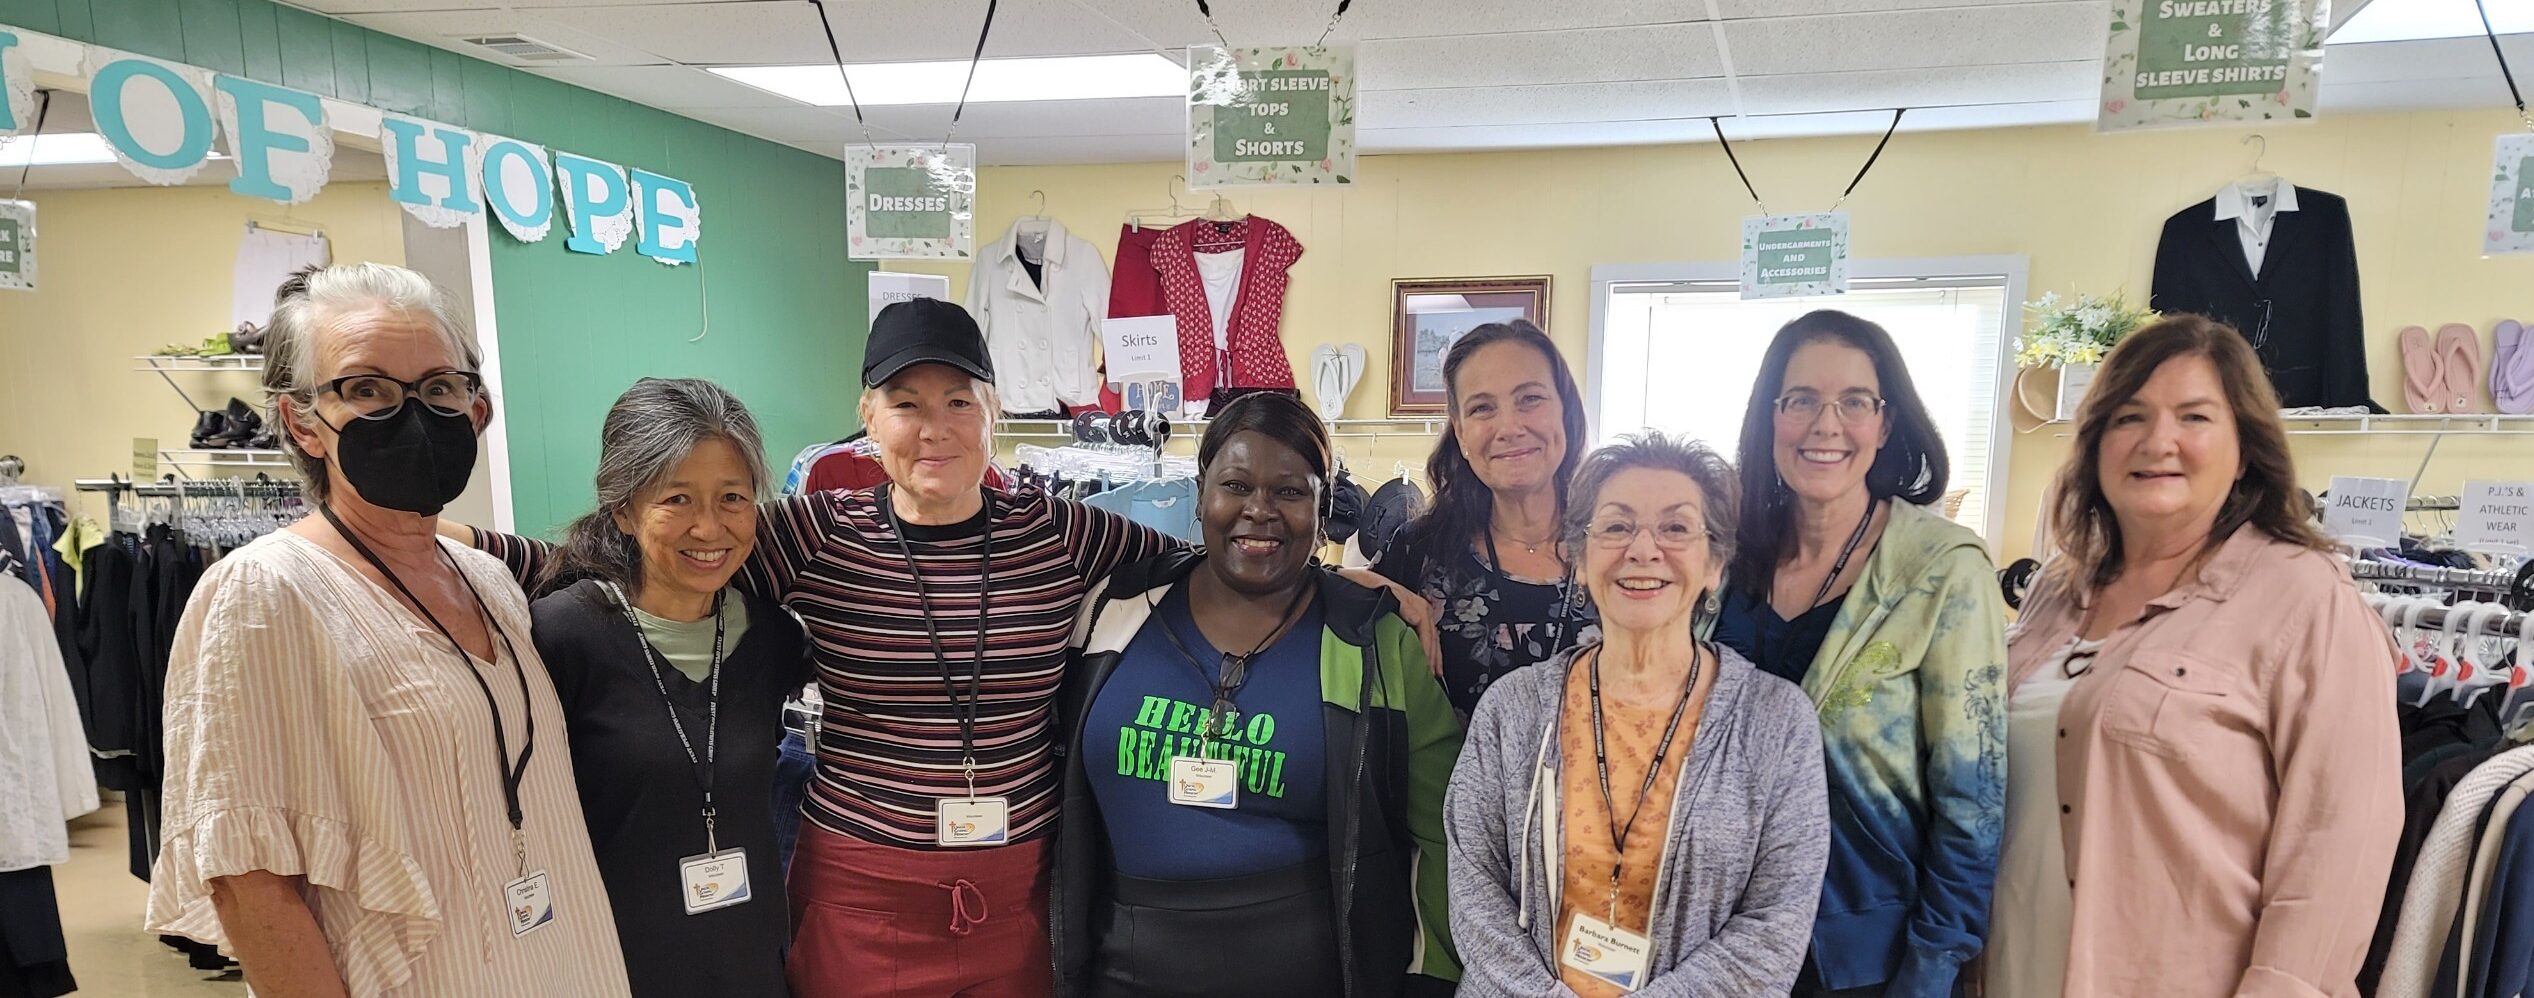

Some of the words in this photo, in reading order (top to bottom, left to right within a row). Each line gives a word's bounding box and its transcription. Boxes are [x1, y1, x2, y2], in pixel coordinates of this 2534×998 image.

[2158, 0, 2273, 19] SWEATERS
[2208, 23, 2223, 37] &
[2183, 43, 2239, 62] LONG
[2136, 69, 2210, 88] SLEEVE
[2212, 65, 2287, 84] SHIRTS
[1270, 77, 1329, 92] SLEEVE
[1248, 102, 1289, 117] TOPS
[1264, 122, 1275, 135] &
[1234, 138, 1305, 156] SHORTS
[91, 59, 322, 201] OF
[383, 117, 698, 264] HOPE
[869, 193, 946, 212] DRESSES
[1759, 240, 1831, 251] UNDERGARMENTS
[1782, 253, 1806, 263] AND
[1760, 266, 1827, 278] ACCESSORIES
[1121, 333, 1158, 347] Skirts
[2516, 486, 2525, 497] &
[2336, 494, 2396, 512] JACKETS
[2479, 505, 2529, 516] ATHLETIC
[2486, 521, 2517, 532] WEAR
[1134, 695, 1275, 746] HELLO
[1579, 925, 1609, 943] Barbara
[1610, 937, 1640, 955] Burnett
